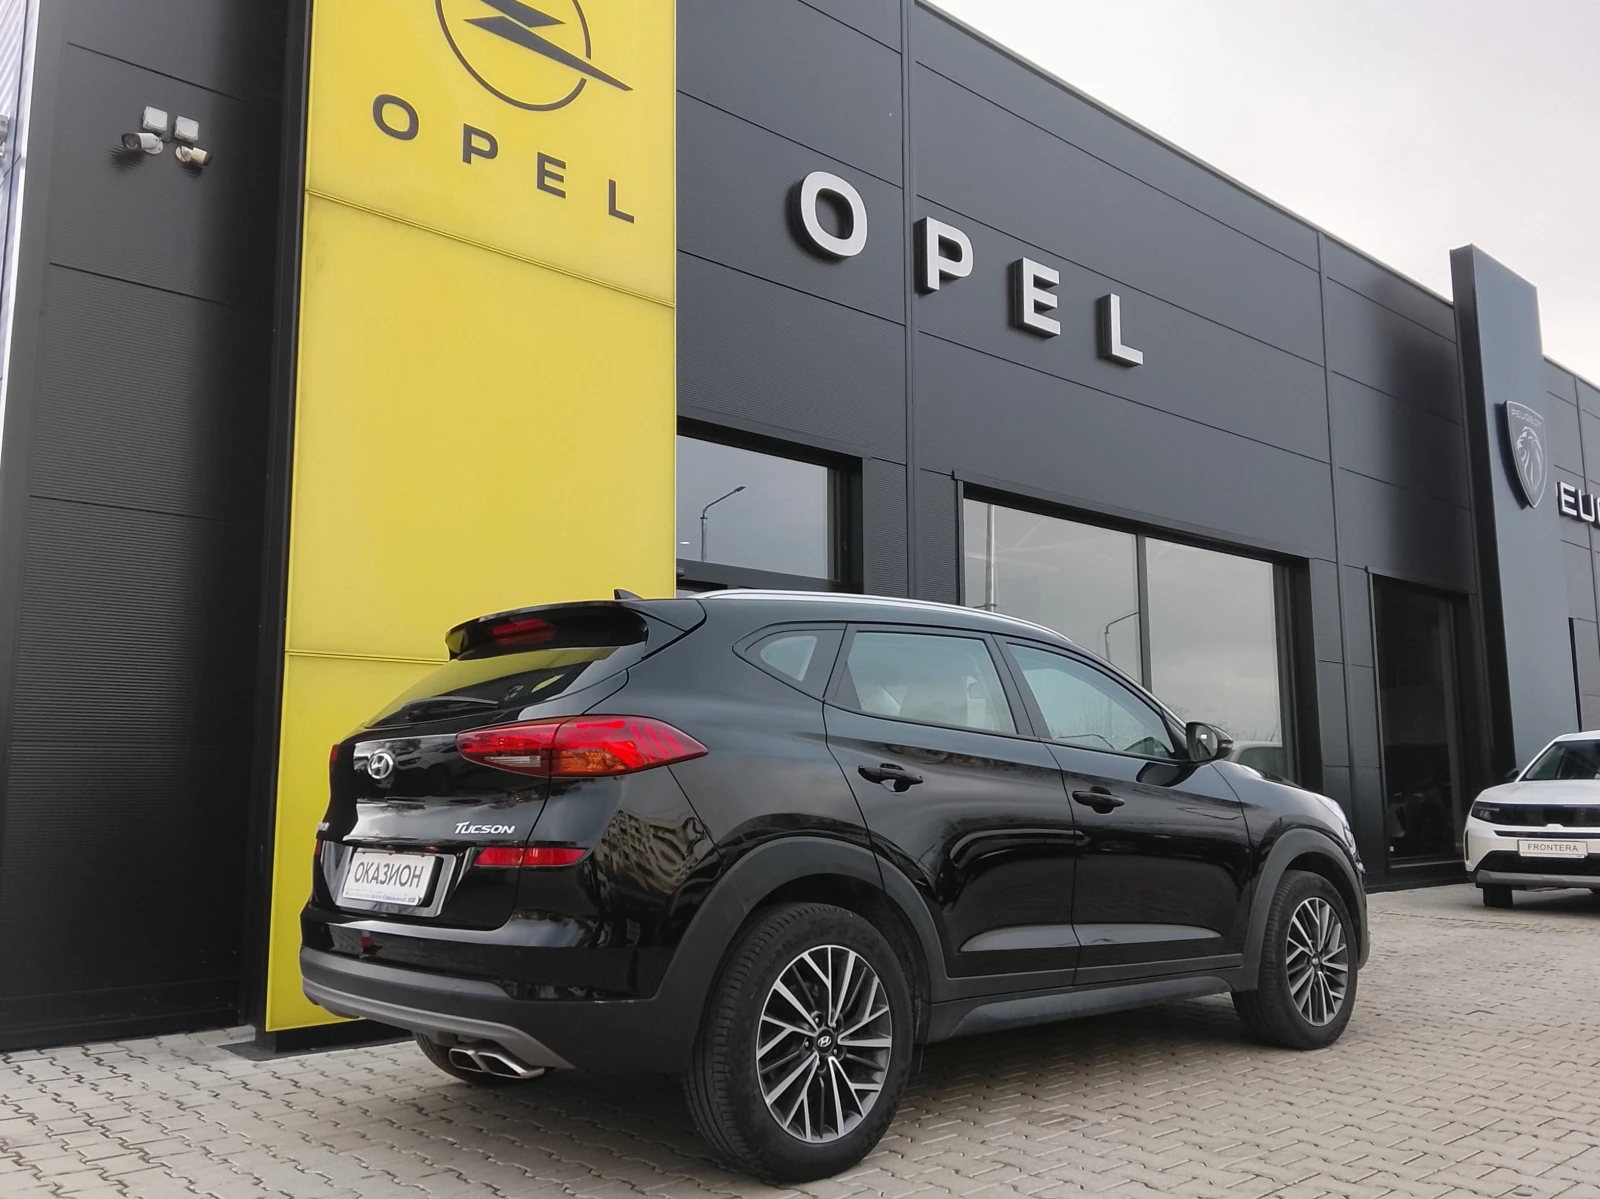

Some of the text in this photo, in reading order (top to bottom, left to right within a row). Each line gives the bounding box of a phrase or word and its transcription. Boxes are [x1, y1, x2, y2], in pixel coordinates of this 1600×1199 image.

[372, 93, 635, 224] OPEL
[800, 170, 1144, 366] OPEL
[1558, 481, 1600, 526] EU
[1527, 843, 1579, 852] FRONTERA
[354, 861, 425, 889] ОКАЗИОН
